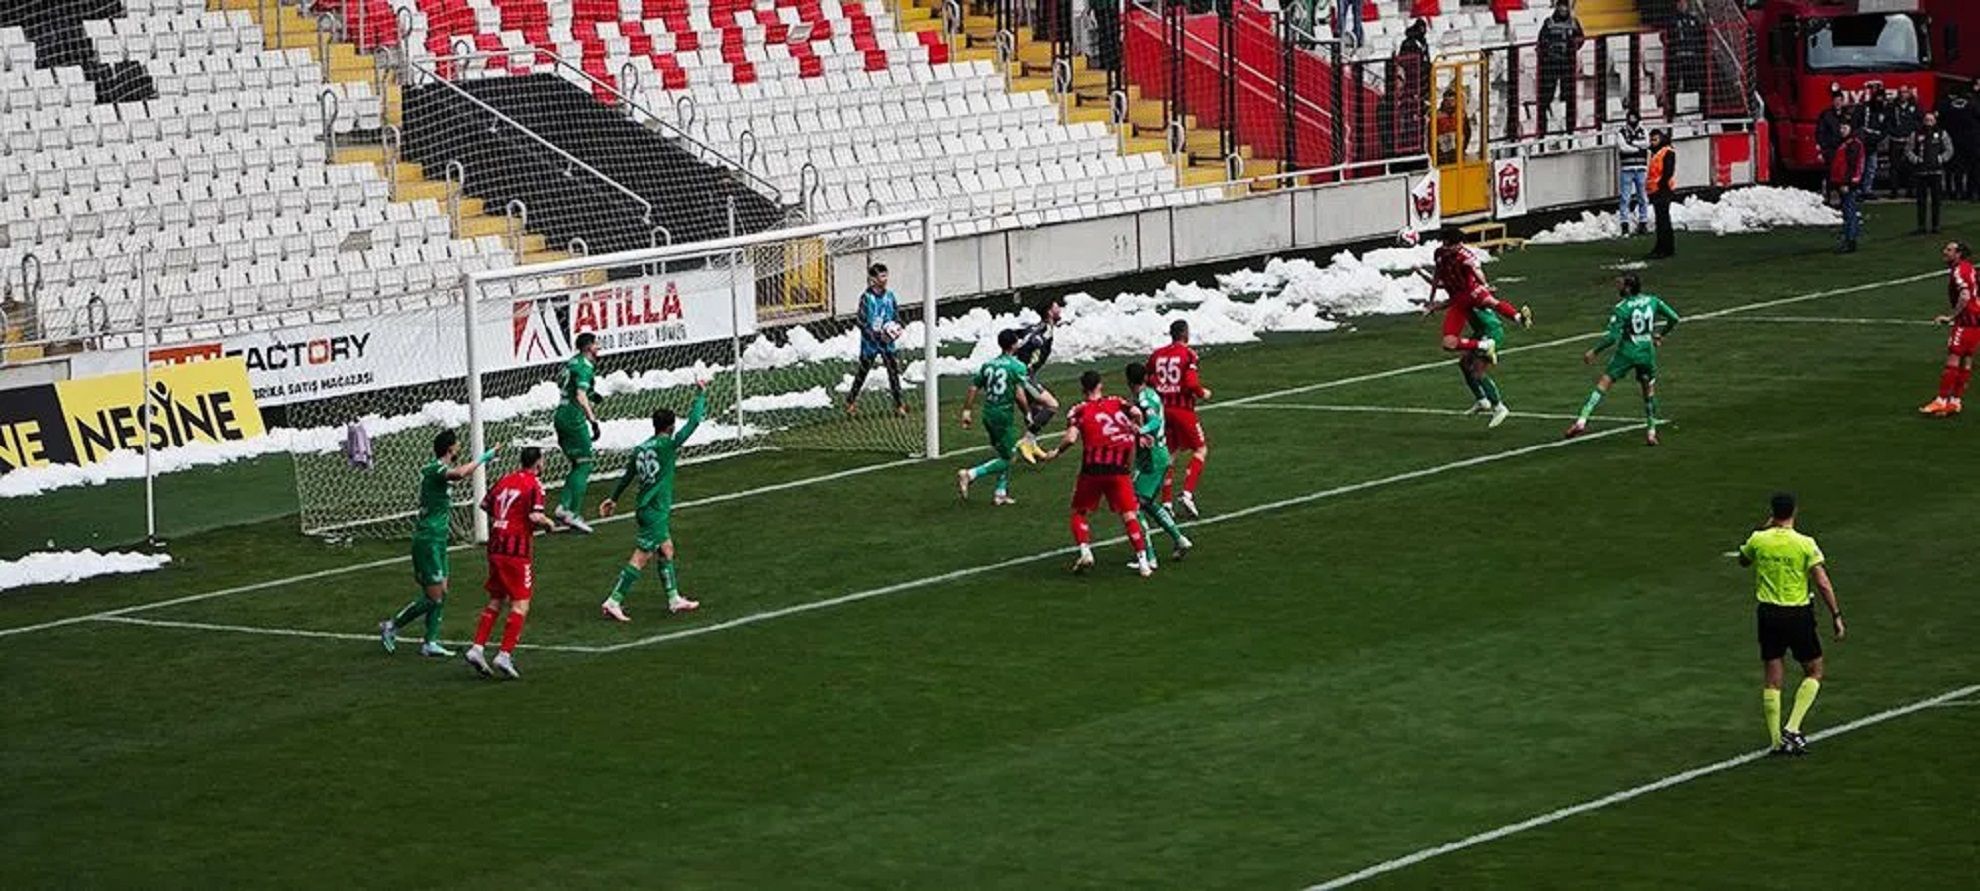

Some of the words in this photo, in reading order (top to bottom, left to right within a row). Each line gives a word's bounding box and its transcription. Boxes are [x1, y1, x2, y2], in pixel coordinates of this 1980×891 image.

[1631, 305, 1654, 334] 61
[226, 332, 370, 371] ACTORY
[984, 366, 1007, 395] 23
[1156, 356, 1181, 384] 55
[497, 487, 521, 519] 17
